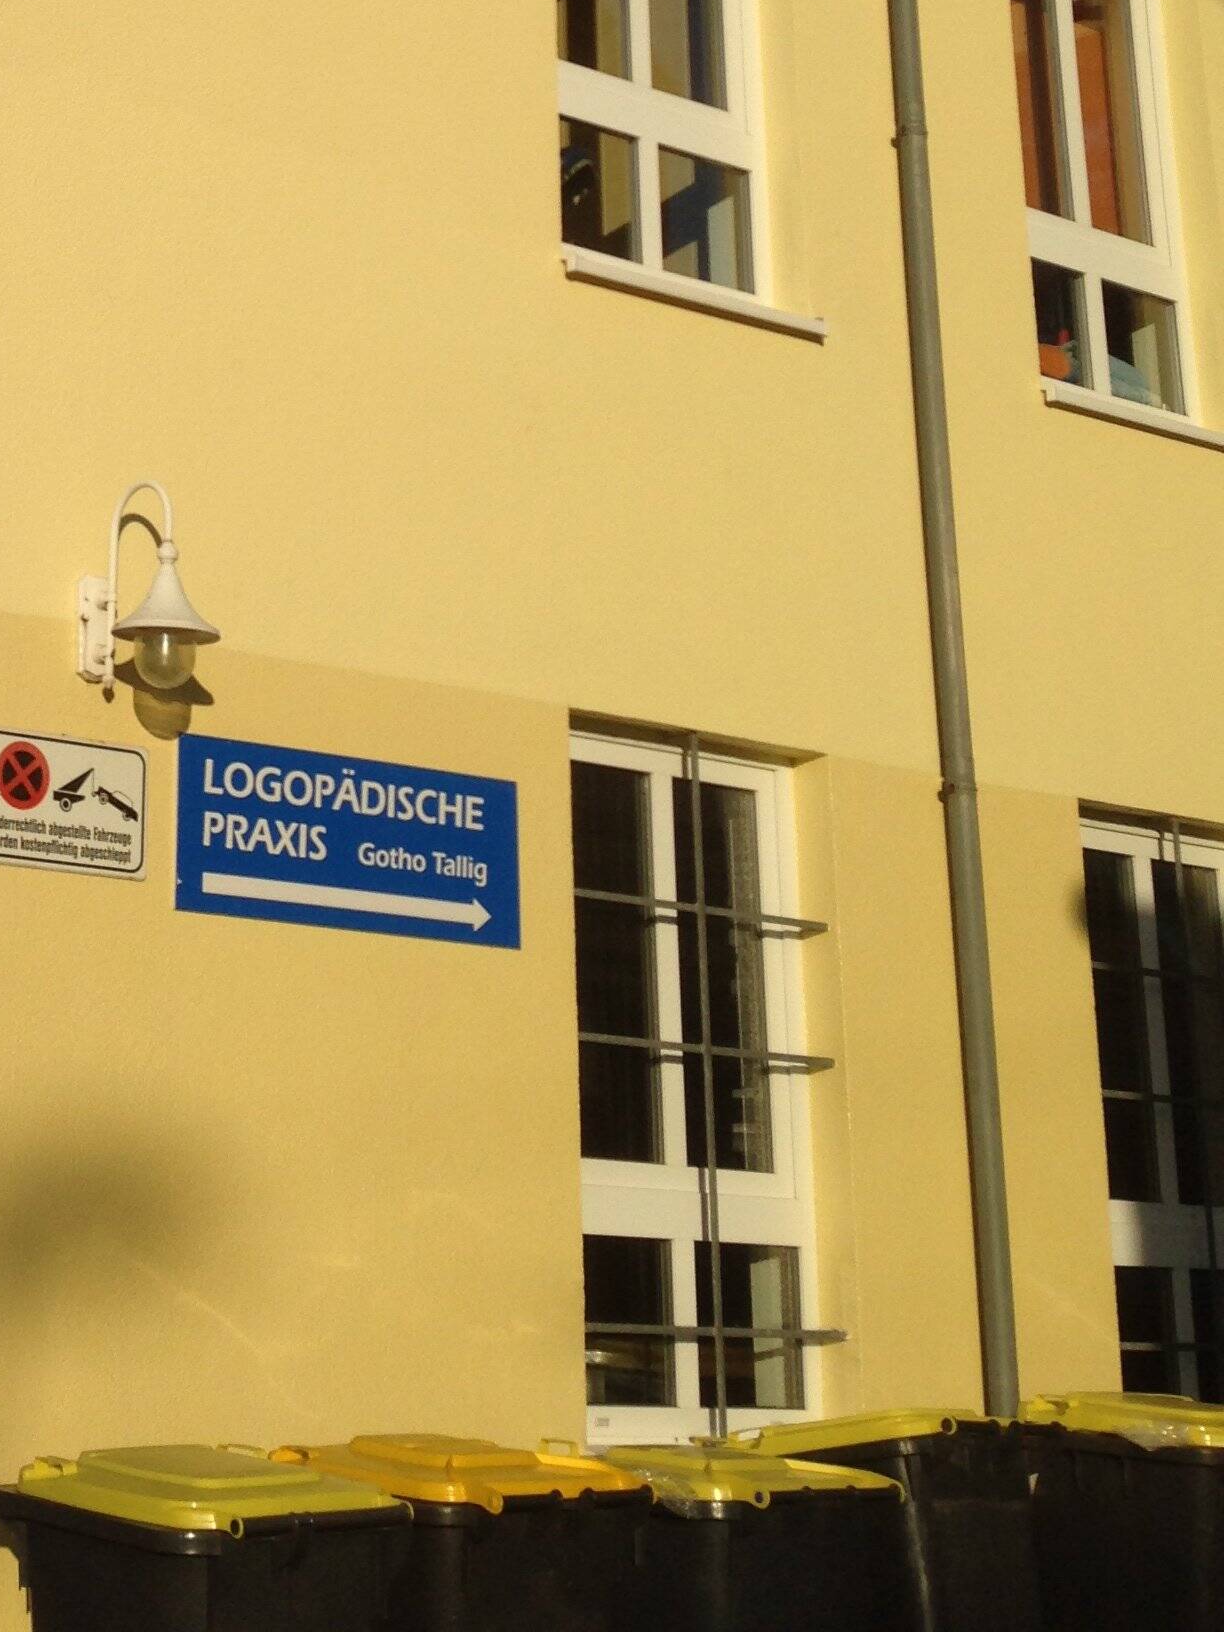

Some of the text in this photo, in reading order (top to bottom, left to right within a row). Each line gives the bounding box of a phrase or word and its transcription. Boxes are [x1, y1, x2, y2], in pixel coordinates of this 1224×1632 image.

[203, 758, 485, 831] LOGOPÄDISCHE
[20, 835, 79, 859] kostenpflichtig
[80, 843, 131, 864] abgeschleppt
[49, 821, 91, 840] abgestellte
[93, 825, 132, 847] Fahrzeuge
[202, 811, 327, 861] PRAXIS
[358, 842, 487, 887] Gotho Tallig
